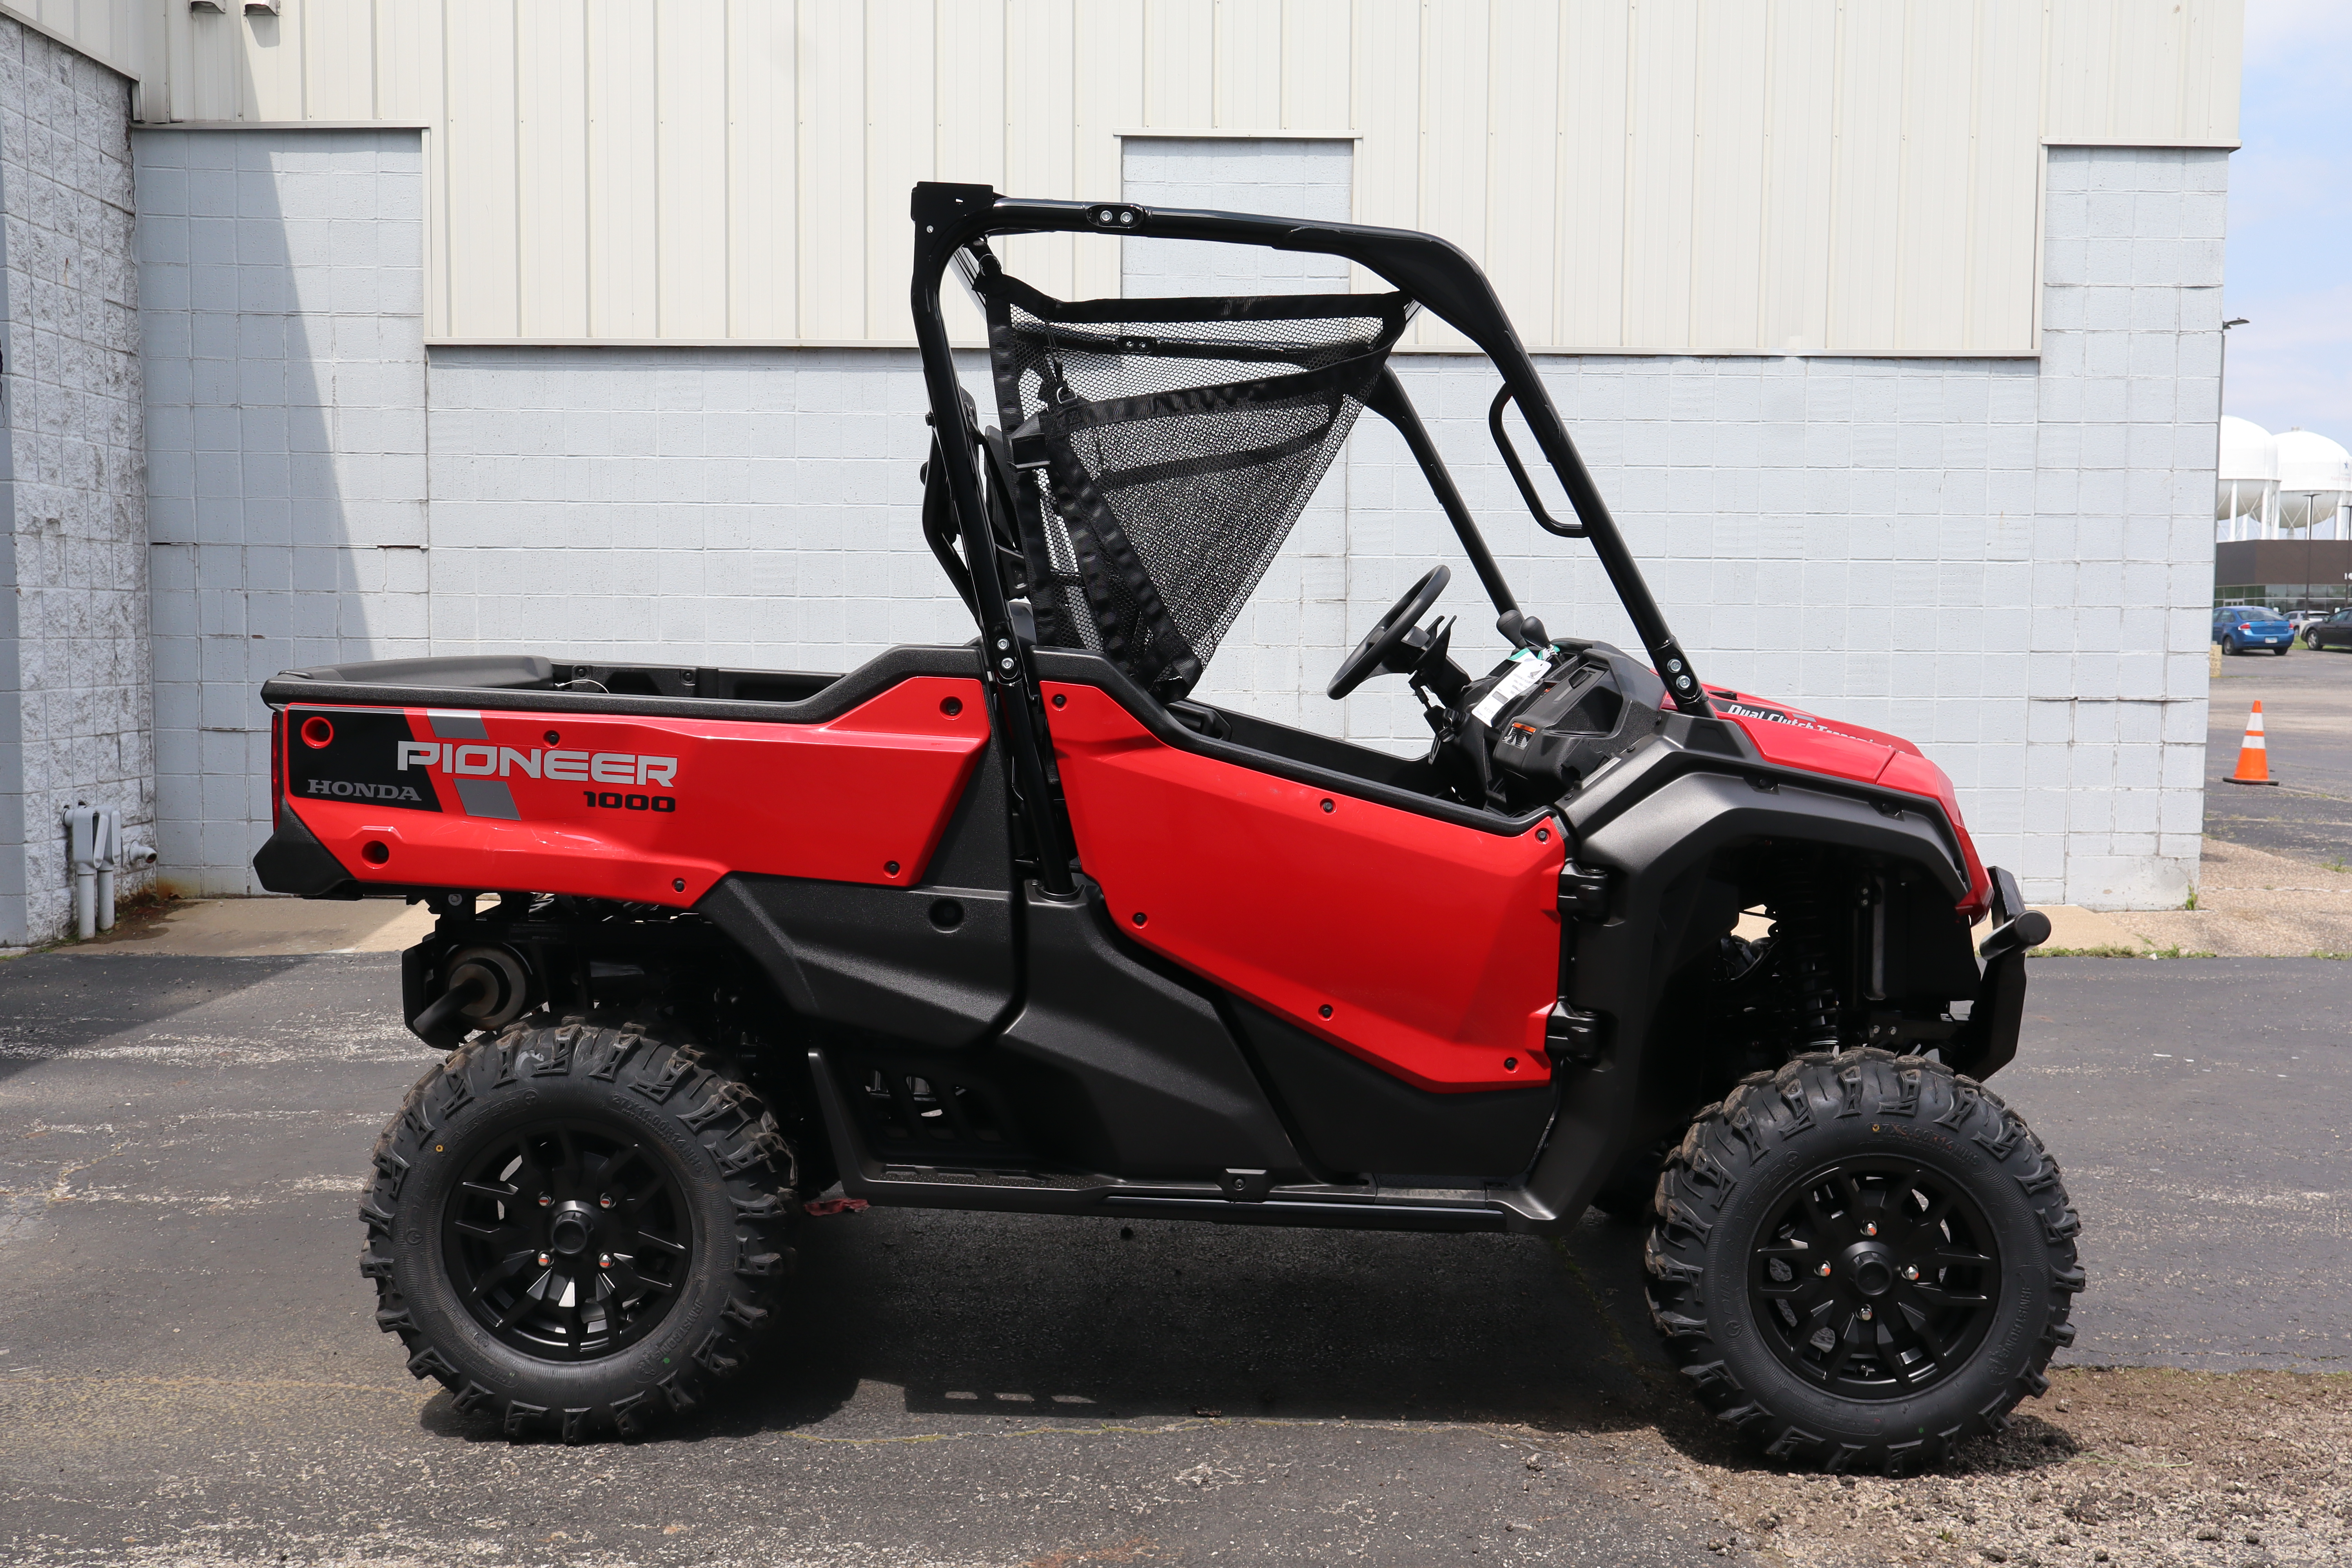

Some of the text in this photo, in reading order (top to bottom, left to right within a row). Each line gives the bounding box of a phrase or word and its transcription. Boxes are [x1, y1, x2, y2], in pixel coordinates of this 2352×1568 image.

[1728, 704, 1766, 719] Dual
[397, 740, 677, 788] PIONEER
[307, 779, 421, 801] HONDA
[584, 791, 675, 813] 1000
